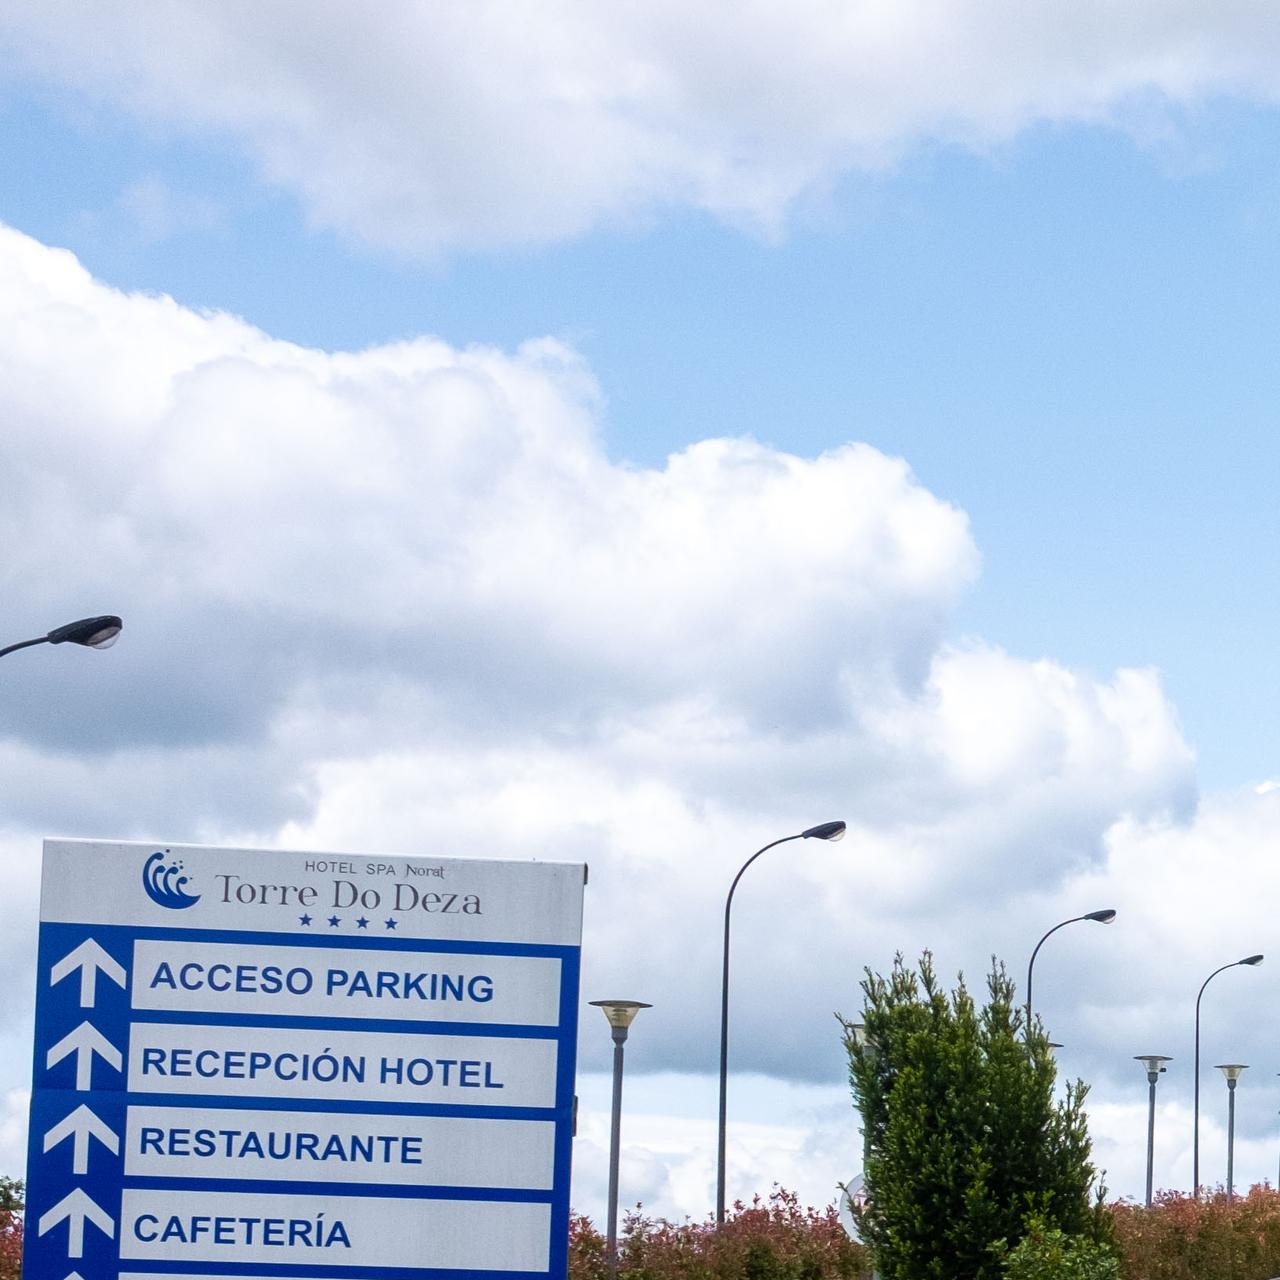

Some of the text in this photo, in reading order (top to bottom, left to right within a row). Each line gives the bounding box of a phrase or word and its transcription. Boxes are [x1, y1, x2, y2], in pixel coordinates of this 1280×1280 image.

[304, 860, 445, 880] HOTEL SPA Norat
[215, 874, 483, 915] Torre Do Deza
[149, 961, 495, 1003] ACCESO PARKING
[141, 1047, 505, 1089] RECEPCIÓN HOTEL
[139, 1127, 424, 1165] RESTAURANTE
[133, 1212, 352, 1249] CAFETERÍA
